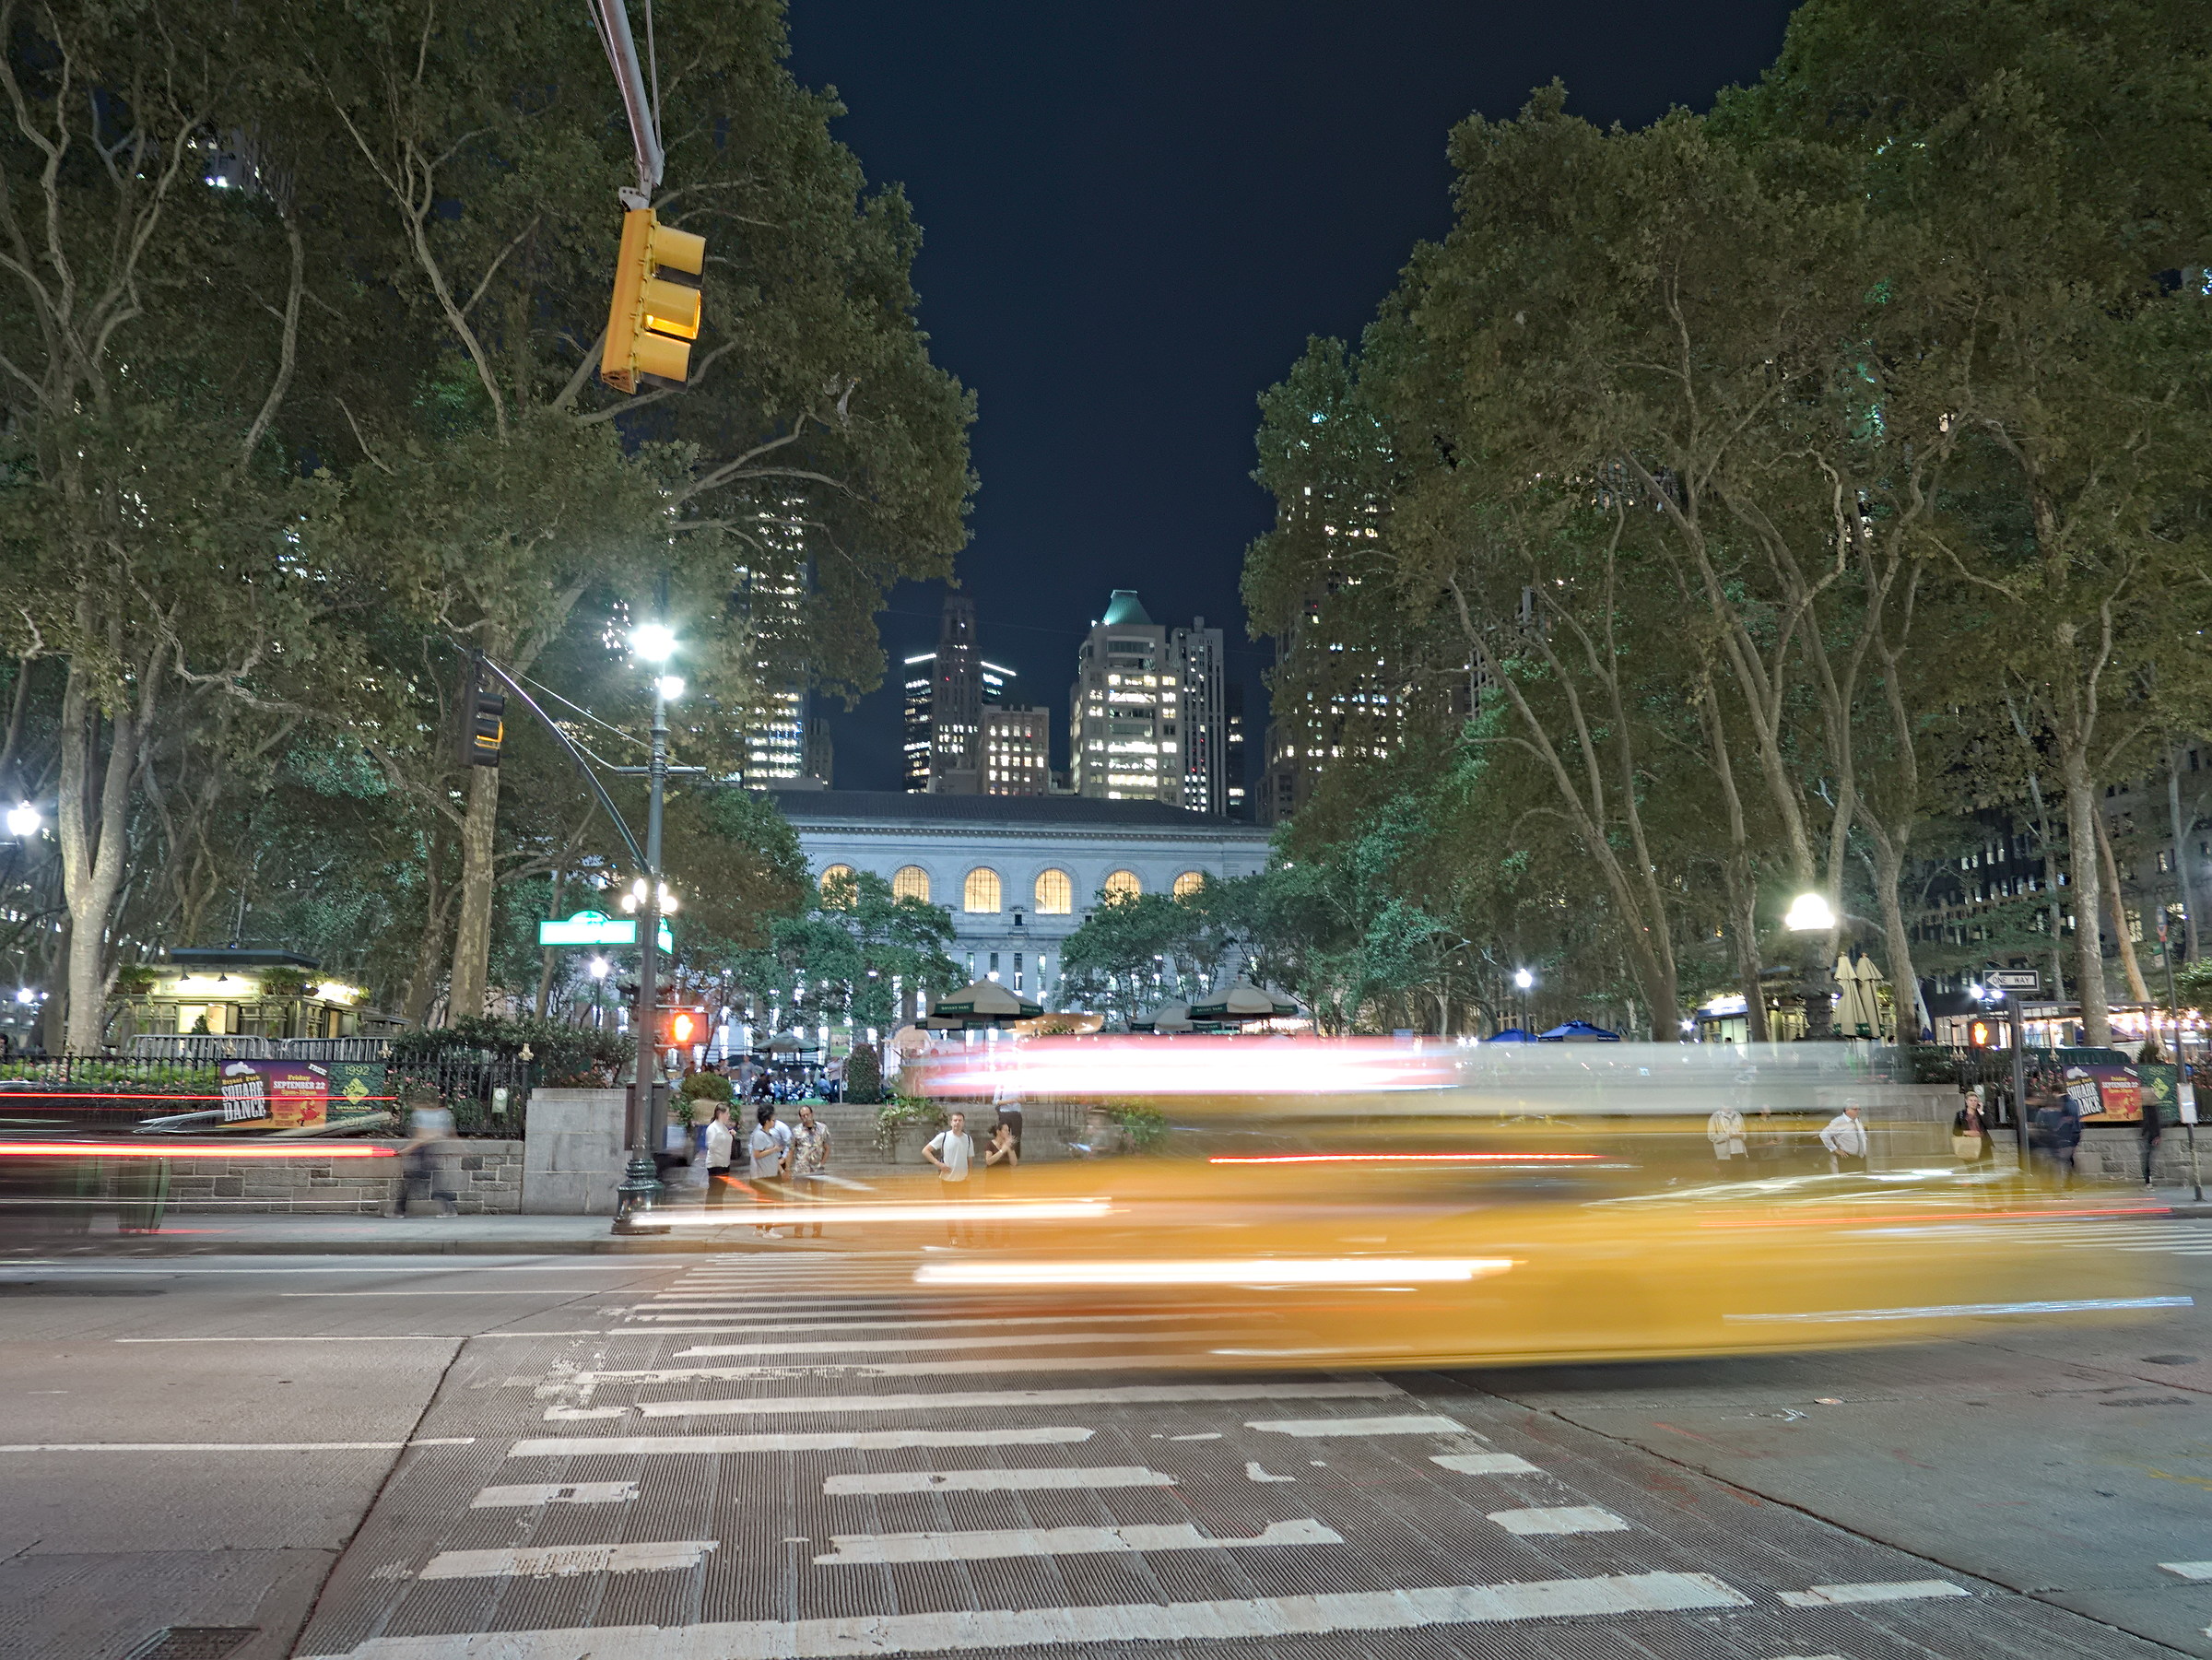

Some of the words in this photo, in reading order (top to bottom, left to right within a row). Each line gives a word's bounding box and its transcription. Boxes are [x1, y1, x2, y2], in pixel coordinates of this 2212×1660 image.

[1992, 976, 2006, 984] ONE
[2014, 976, 2030, 984] WAY
[345, 1065, 370, 1076] 1992
[221, 1080, 265, 1102] SQUARE
[2066, 1082, 2098, 1101] SQUARE
[222, 1099, 266, 1122] DANCE
[2077, 1095, 2102, 1116] ANCE
